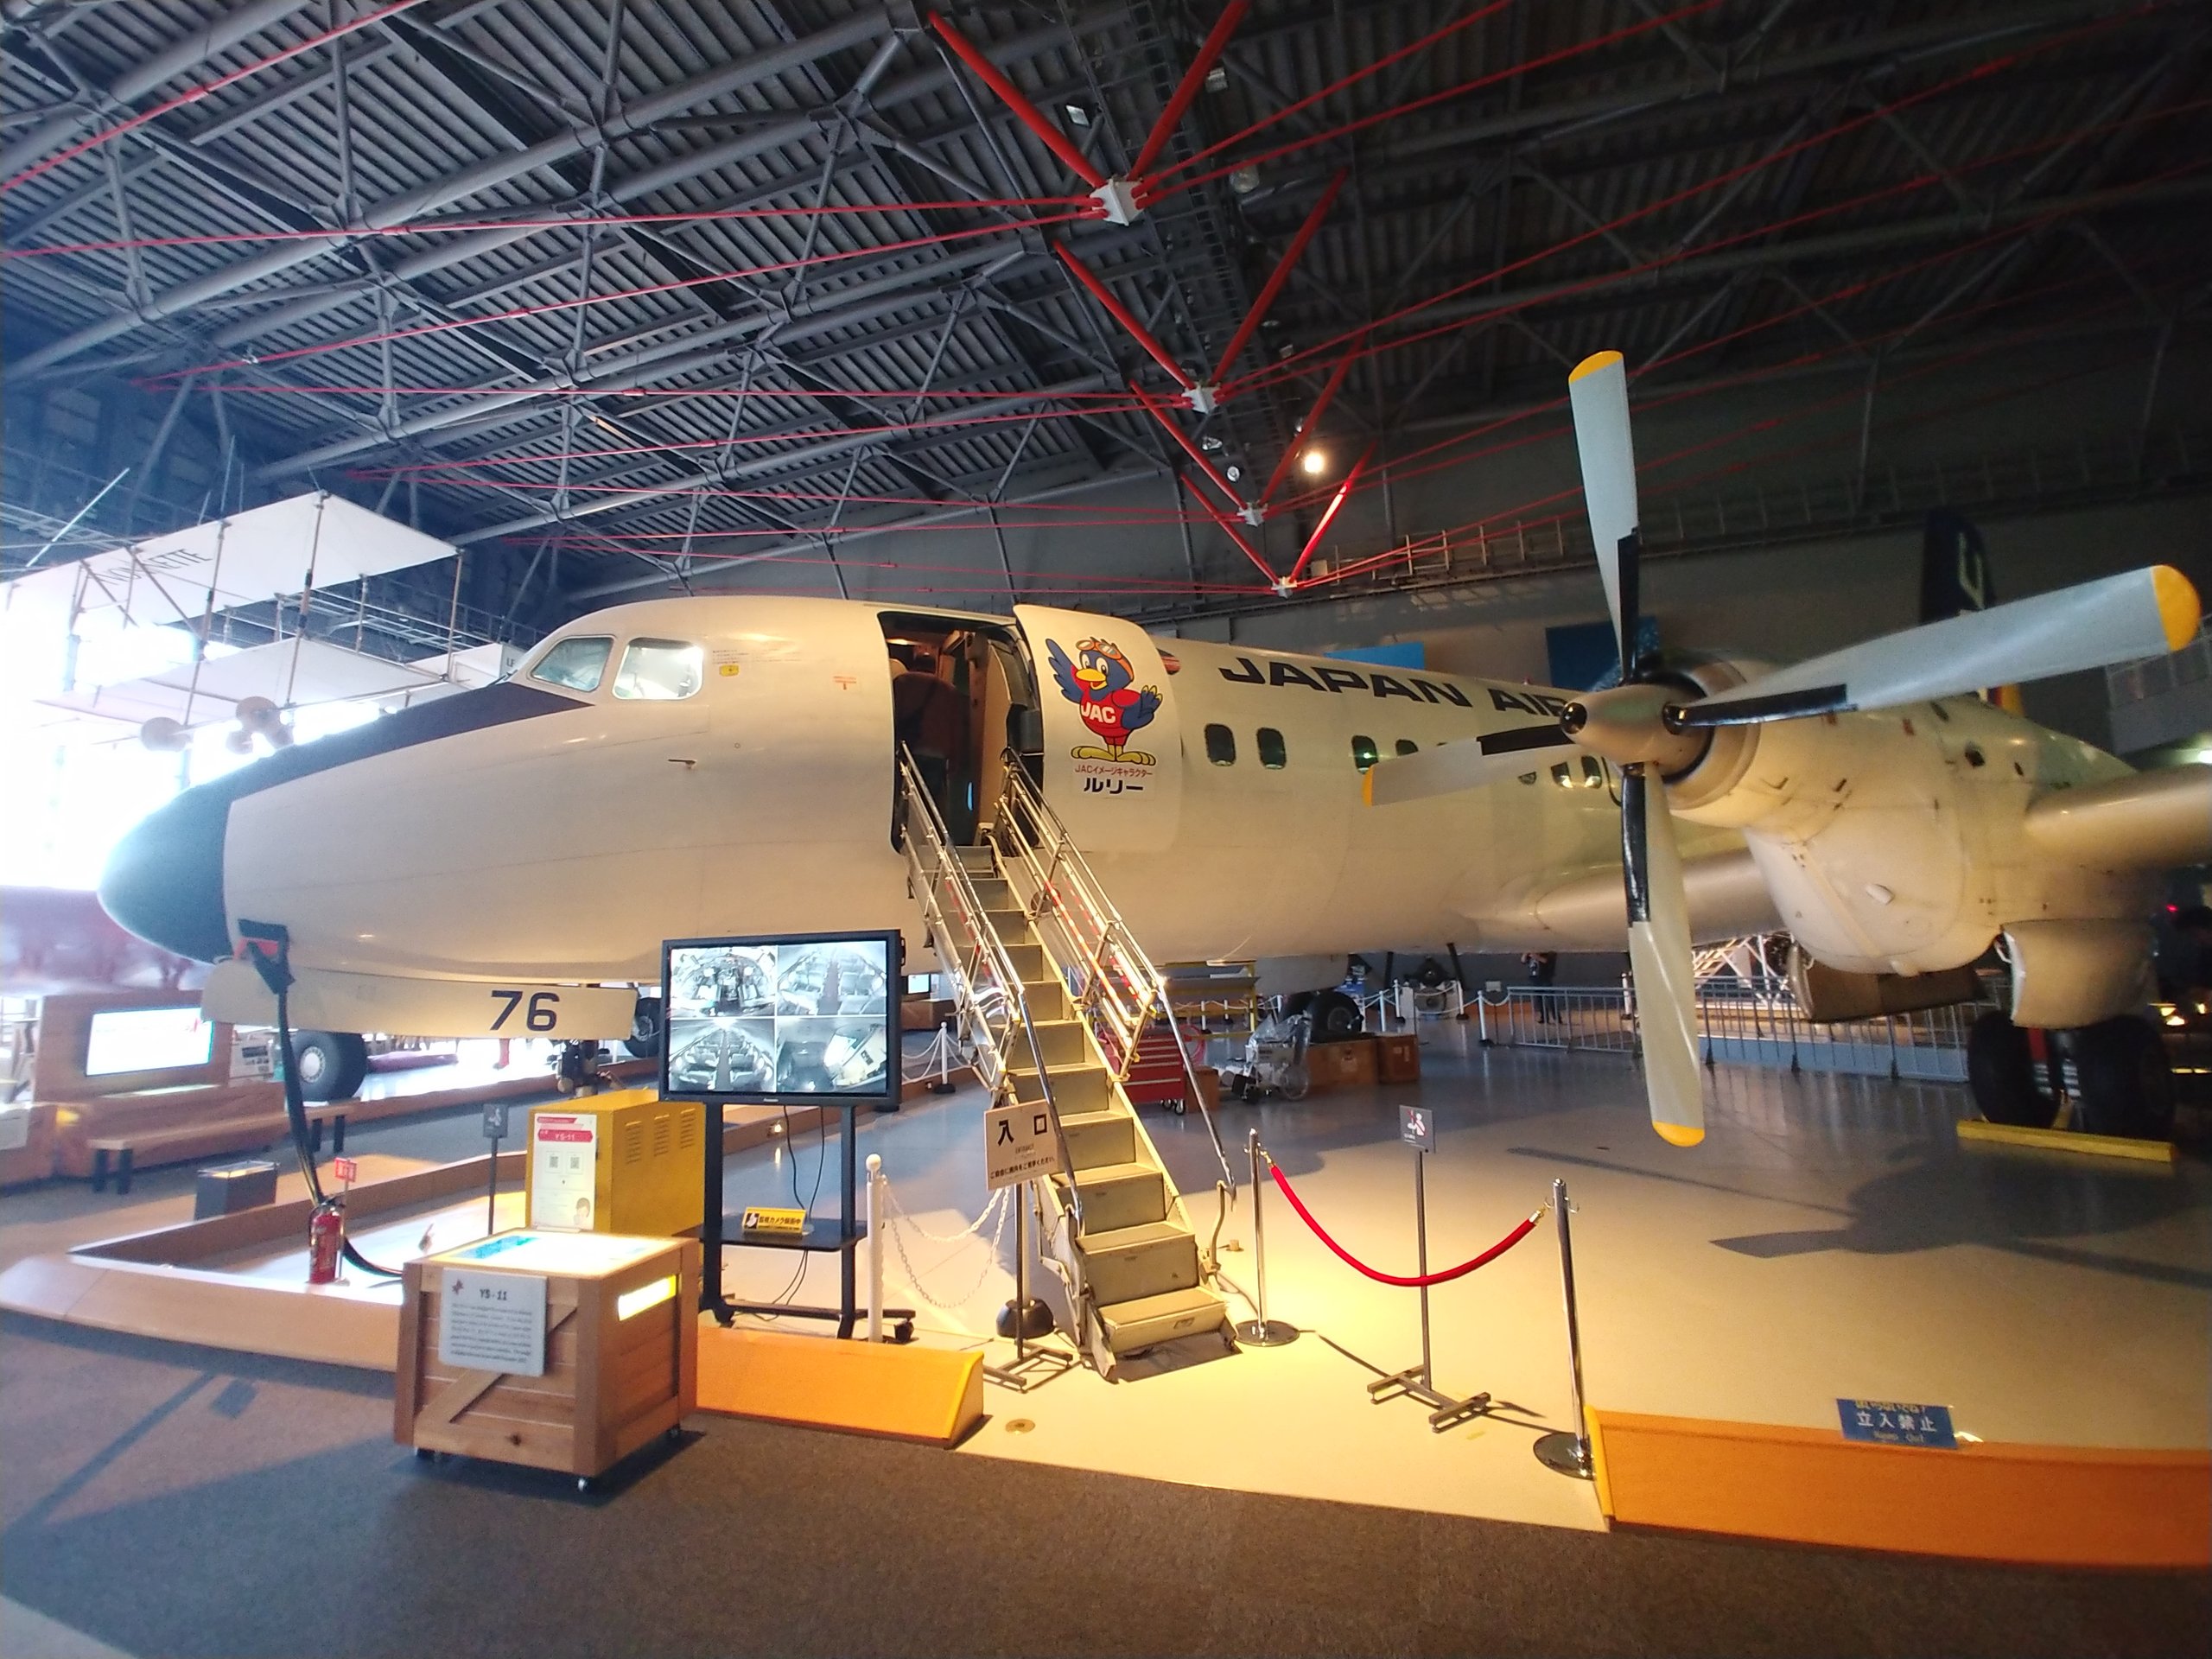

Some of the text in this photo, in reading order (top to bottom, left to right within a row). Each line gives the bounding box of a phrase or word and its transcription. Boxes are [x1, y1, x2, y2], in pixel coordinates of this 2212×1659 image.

[1218, 657, 1473, 708] JAPAN
[1080, 702, 1116, 724] JAC
[1075, 764, 1153, 779] JACイメージキャラクター
[1084, 778, 1143, 794] ルリー
[490, 990, 560, 1031] 76
[997, 1114, 1047, 1147] 入口
[1856, 1411, 1937, 1433] 立入禁止
